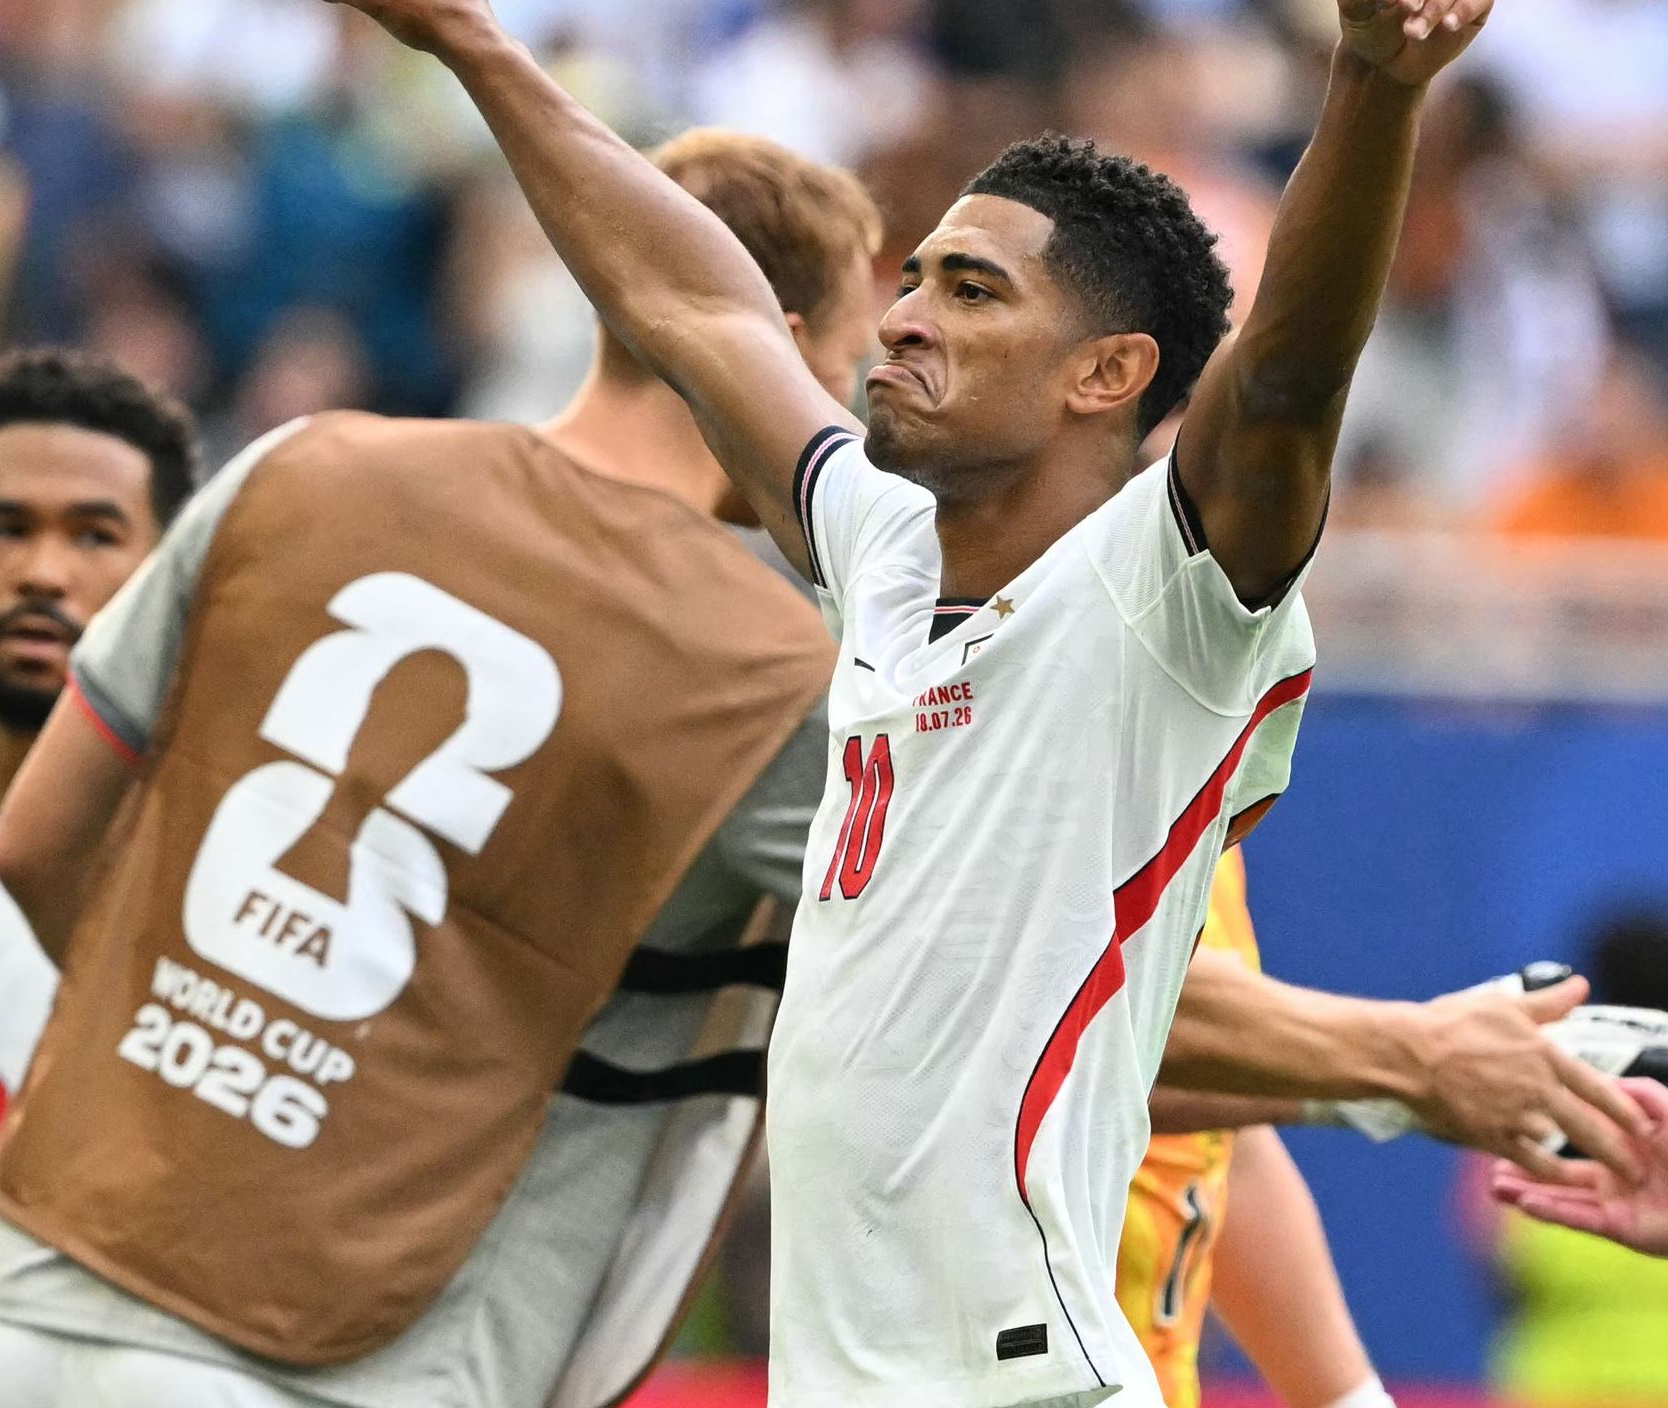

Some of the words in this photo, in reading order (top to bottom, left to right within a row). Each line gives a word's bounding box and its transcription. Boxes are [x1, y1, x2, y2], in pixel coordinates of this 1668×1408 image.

[915, 706, 972, 732] 18.07.26
[818, 733, 894, 902] 10
[234, 889, 332, 968] FIFA
[116, 1002, 330, 1149] 2026
[150, 954, 266, 1041] WORLD
[261, 1018, 356, 1085] CUP
